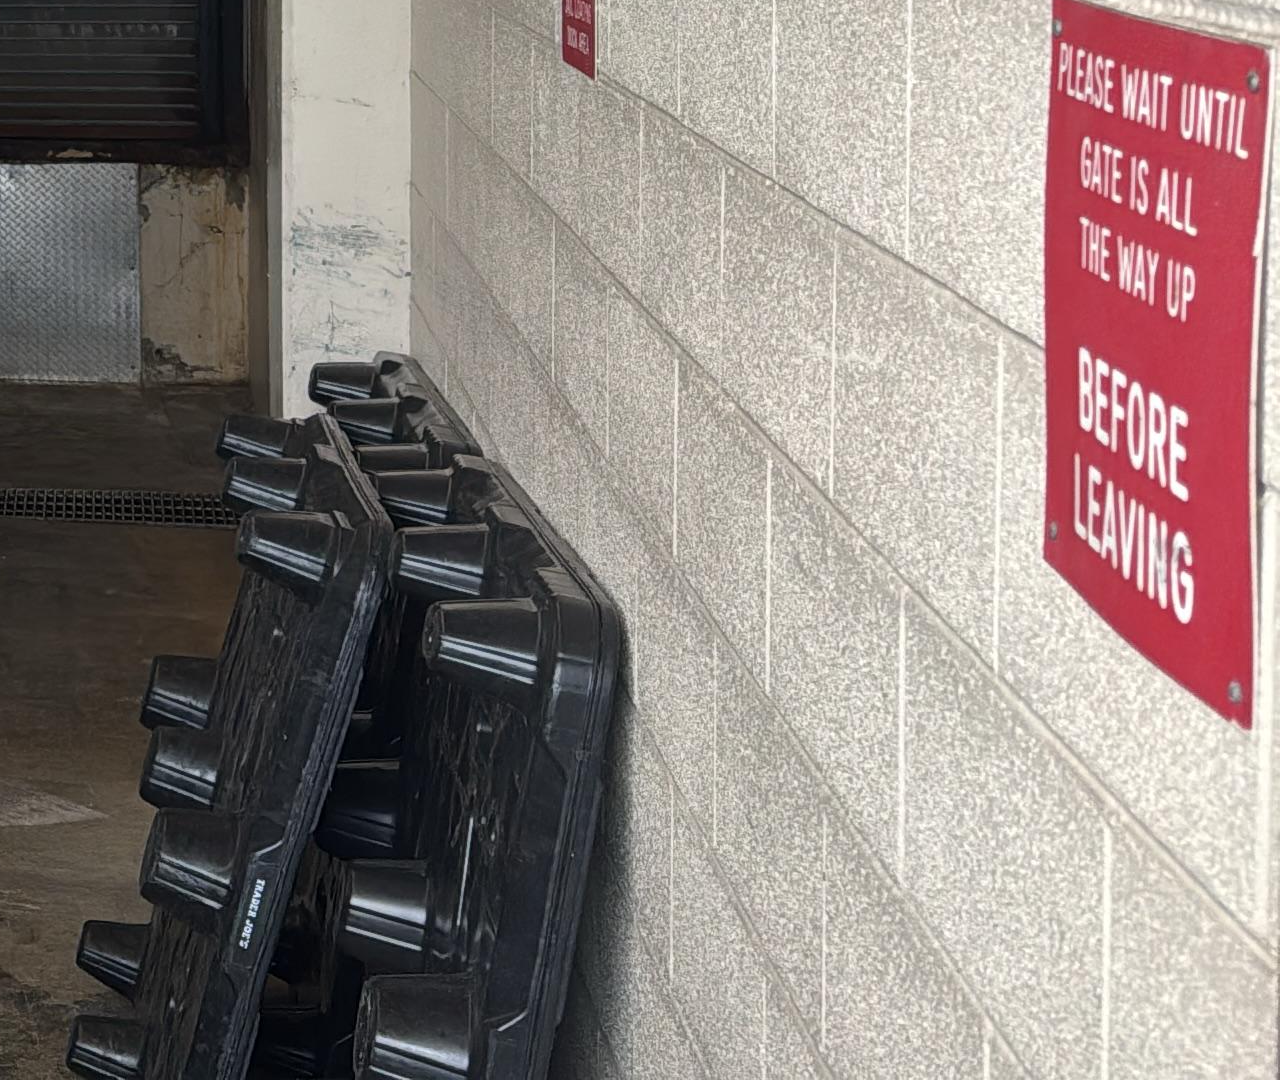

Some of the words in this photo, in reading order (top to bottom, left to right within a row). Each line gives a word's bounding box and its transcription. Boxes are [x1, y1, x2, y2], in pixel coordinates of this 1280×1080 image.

[1057, 41, 1115, 114] PLEASE
[1121, 63, 1174, 132] WAIT
[1179, 81, 1249, 160] UNTIL
[1080, 136, 1124, 204] GATE
[1128, 154, 1150, 215] IS
[1155, 167, 1199, 237] ALL
[1079, 216, 1112, 282] THE
[1116, 235, 1160, 307] WAY
[1165, 257, 1196, 322] UP
[1078, 345, 1189, 503] BEFORE
[1073, 451, 1195, 625] LEAVING
[238, 918, 254, 950] JOE'S
[247, 878, 266, 918] TRADER
